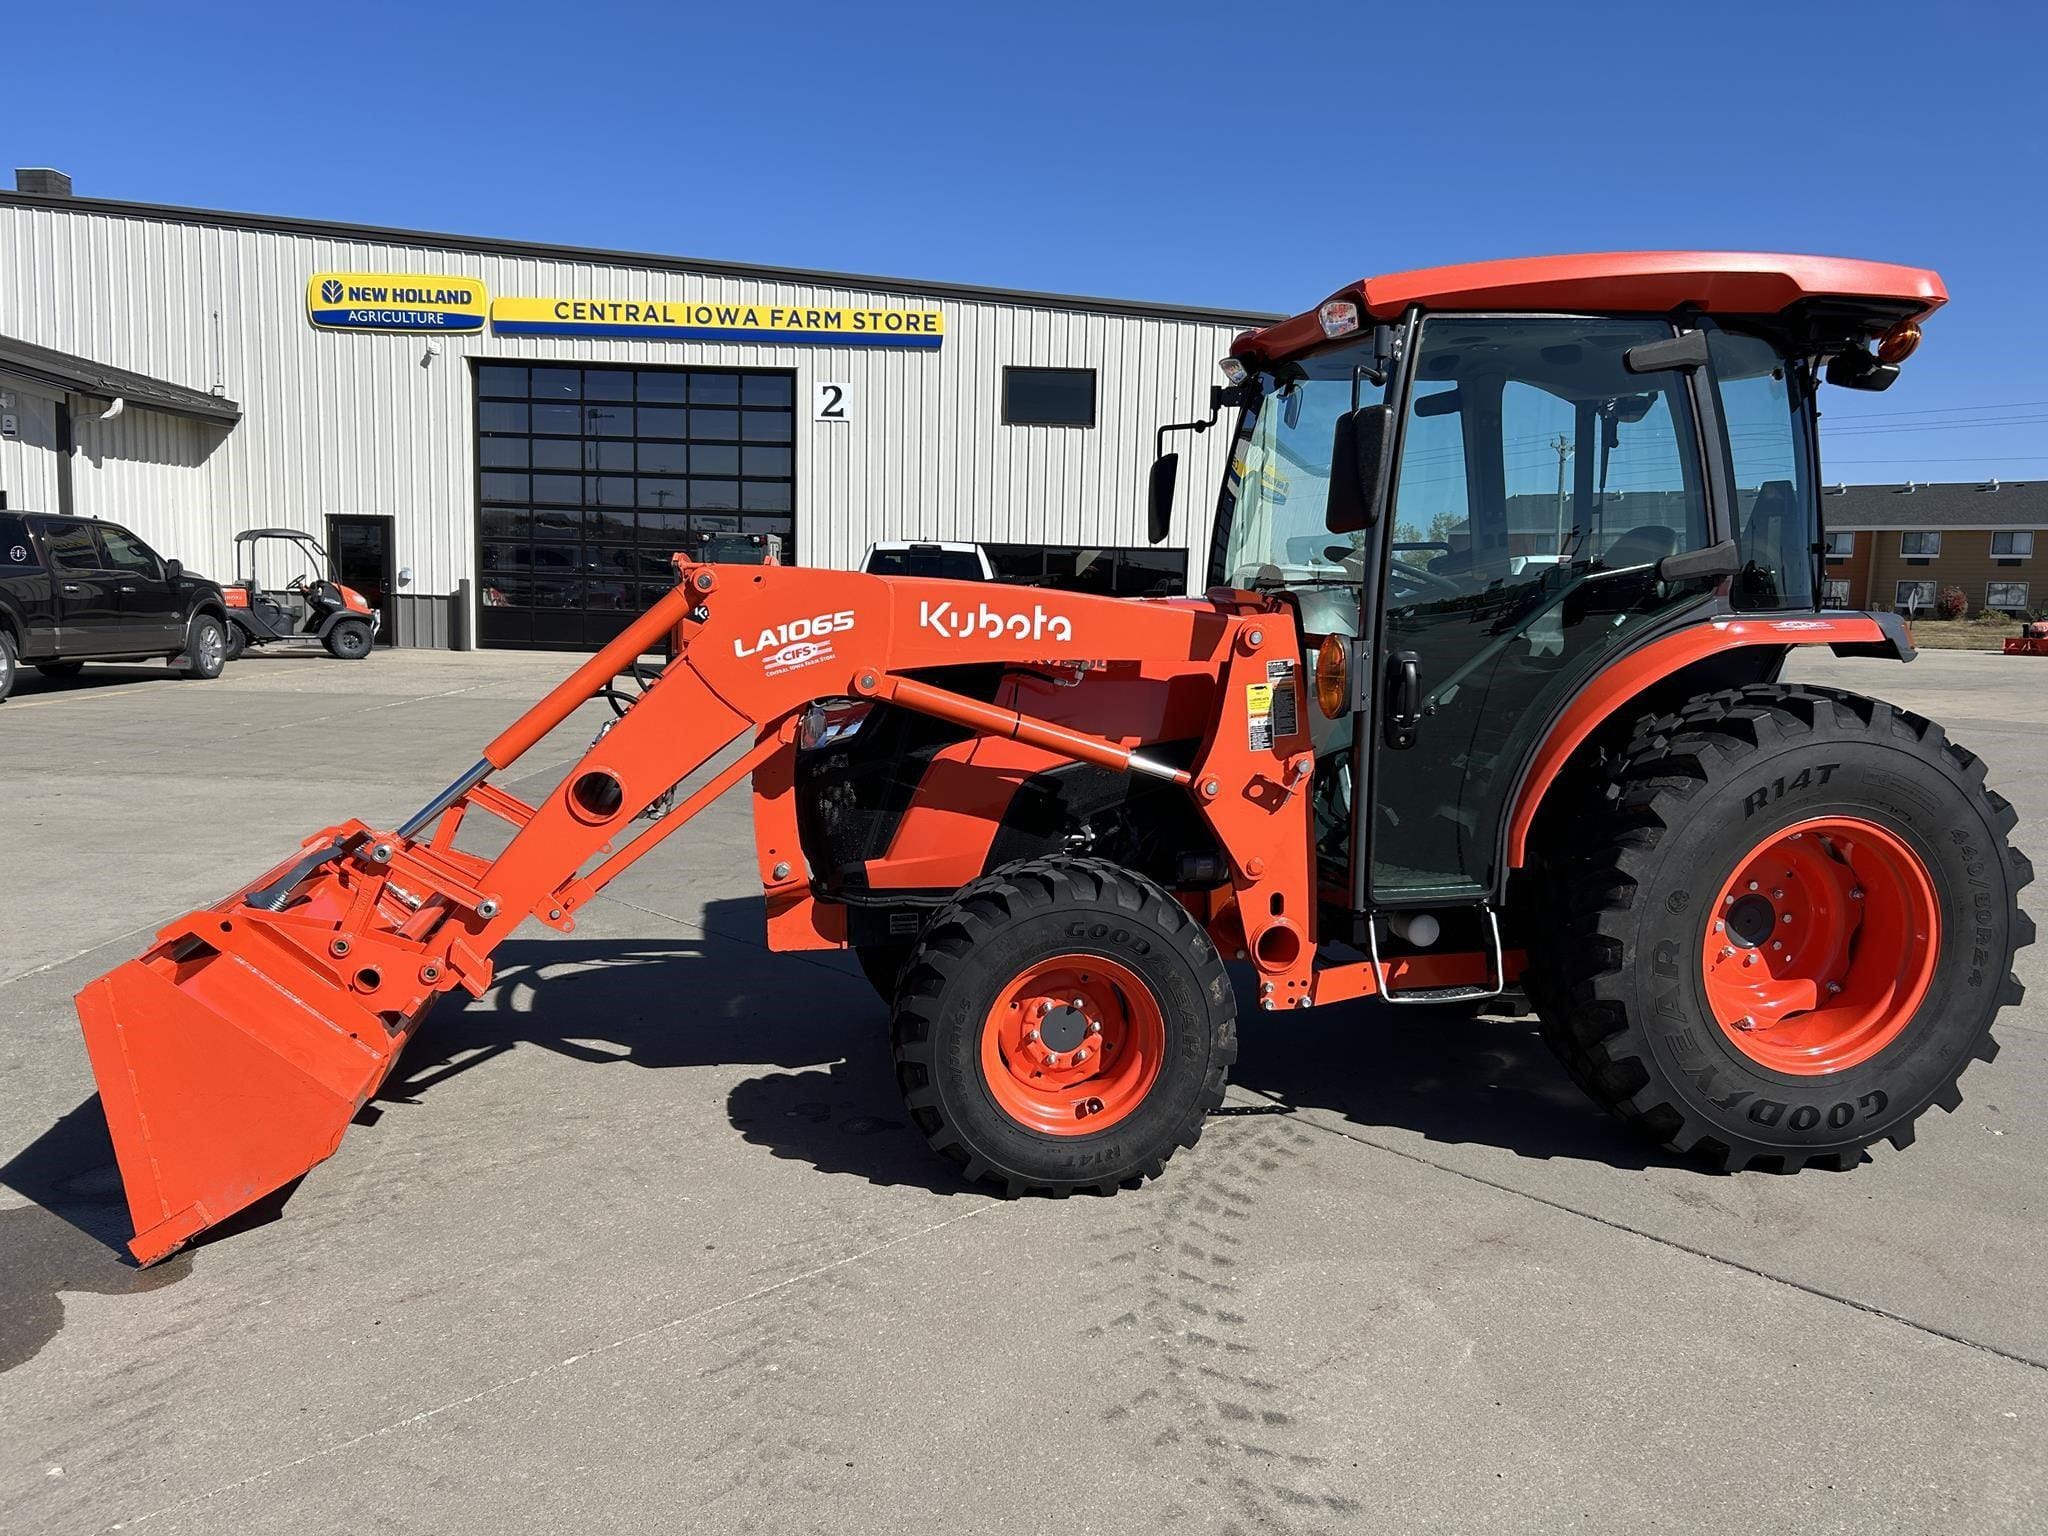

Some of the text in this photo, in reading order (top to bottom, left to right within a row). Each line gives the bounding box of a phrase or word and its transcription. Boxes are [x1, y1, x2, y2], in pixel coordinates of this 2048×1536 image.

[348, 287, 473, 305] NEW HOLLAND
[348, 310, 444, 325] AGRICULTURE
[553, 301, 937, 332] CENTRAL IOWA FARM STORE
[820, 385, 845, 418] 2
[733, 610, 855, 658] LA1065
[919, 600, 1072, 642] Kubota
[782, 646, 812, 662] CIFS
[1743, 763, 1841, 820] R14T
[1064, 921, 1201, 1058] GOODYEAR
[1651, 938, 1889, 1131] GOODYEAR
